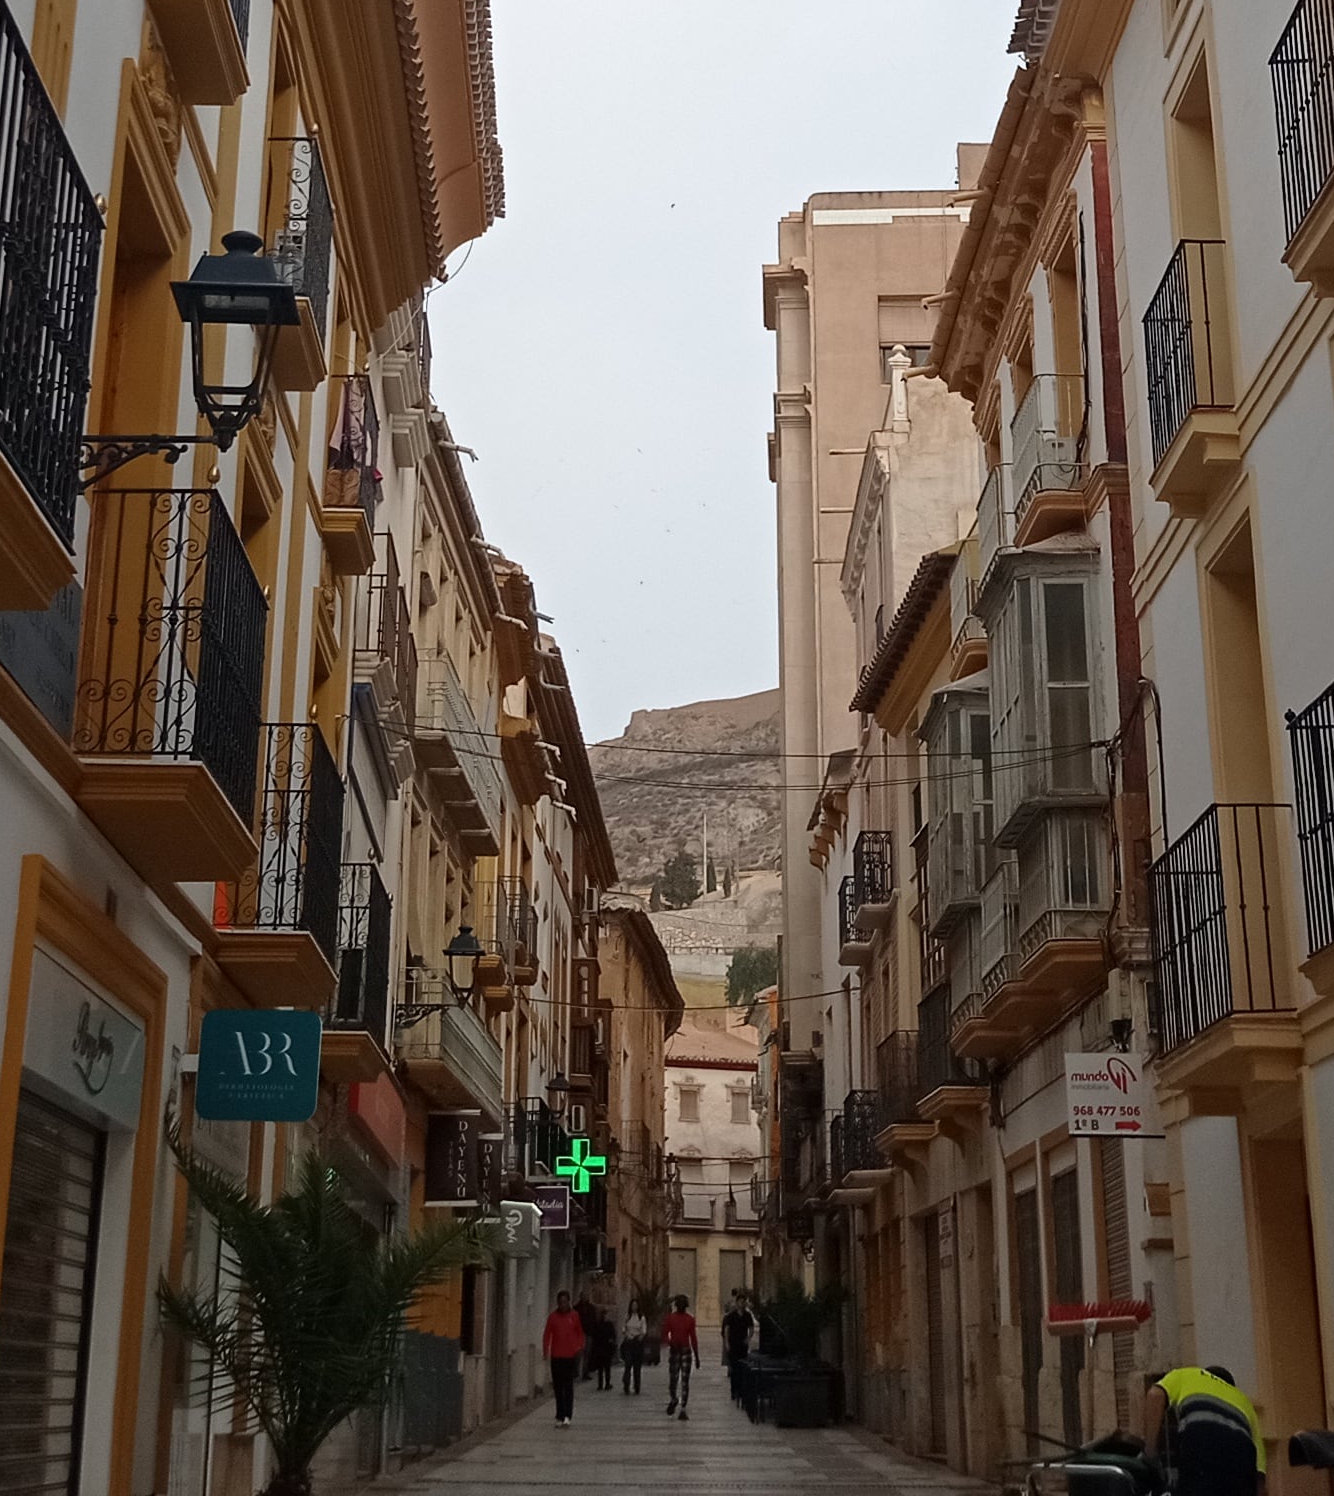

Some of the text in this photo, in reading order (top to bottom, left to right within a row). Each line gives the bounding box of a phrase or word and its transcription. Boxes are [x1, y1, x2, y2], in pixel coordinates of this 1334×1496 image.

[1071, 1070, 1109, 1081] mundo
[1073, 1106, 1140, 1116] 968 477 506
[1091, 1119, 1099, 1130] B
[457, 1120, 468, 1197] DAYENÚ
